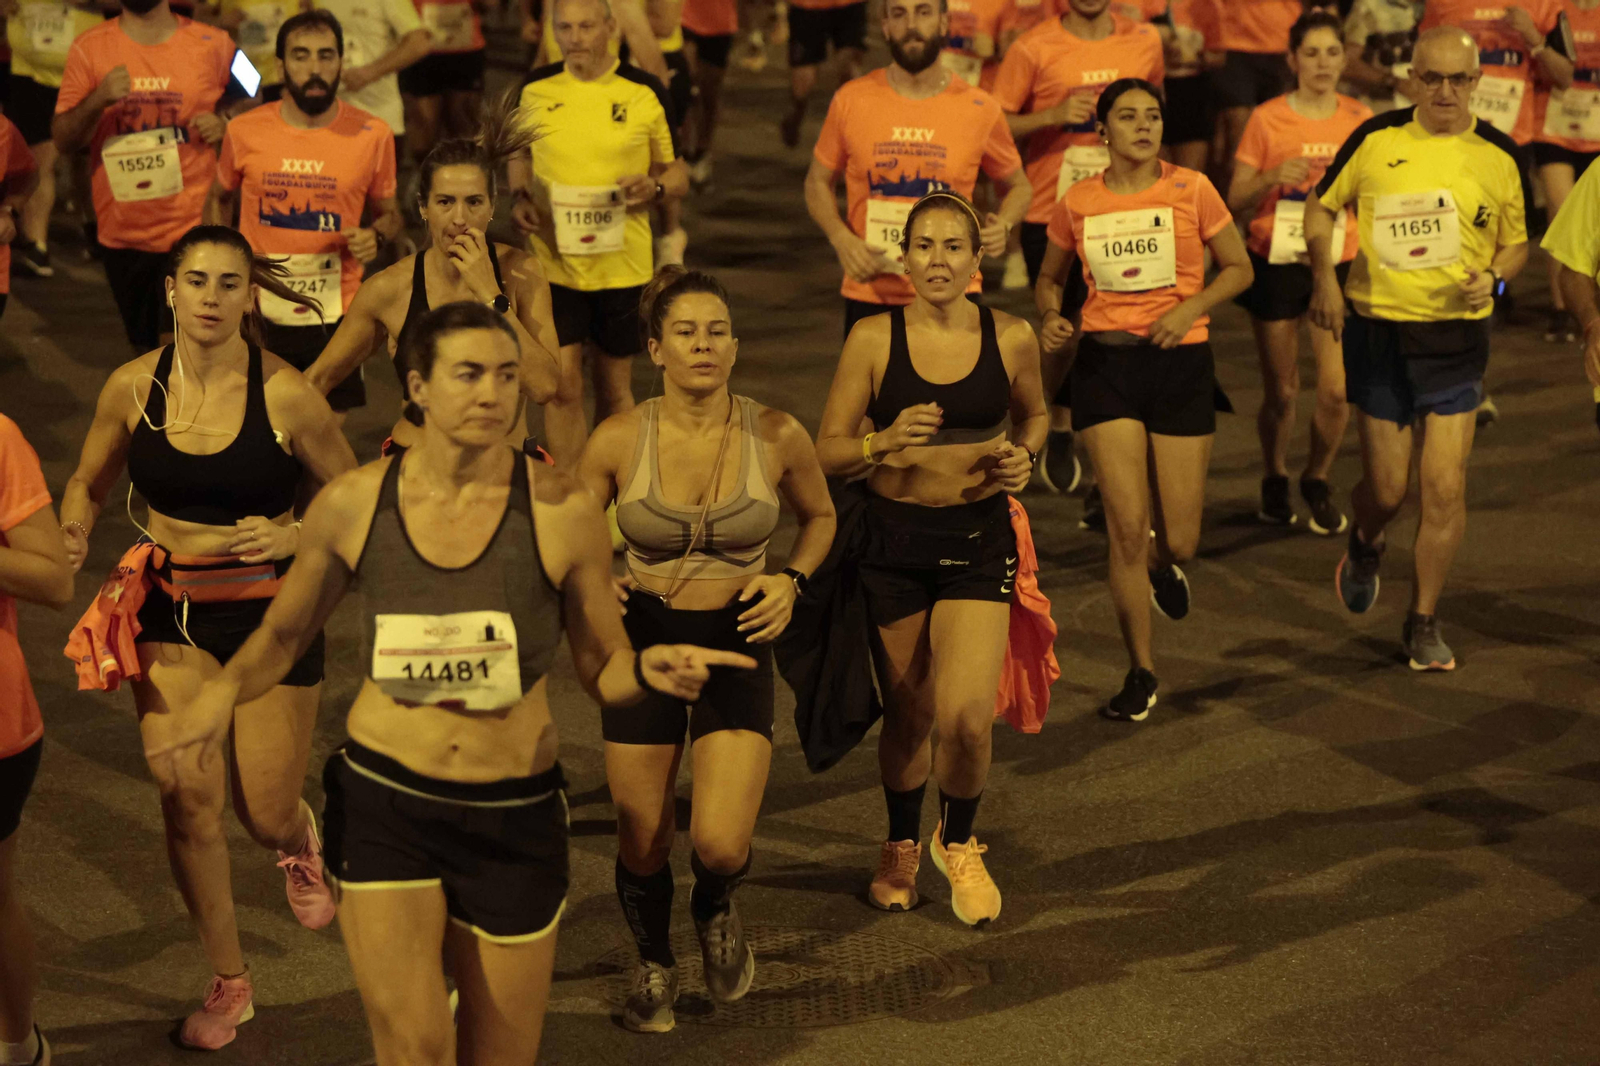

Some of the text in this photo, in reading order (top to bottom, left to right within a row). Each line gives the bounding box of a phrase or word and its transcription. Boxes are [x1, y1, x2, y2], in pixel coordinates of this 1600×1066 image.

[133, 77, 171, 91] XXXV
[891, 126, 935, 142] XXXV
[118, 154, 166, 173] 15525
[281, 158, 325, 174] XXXV
[565, 209, 613, 226] 11806
[1388, 217, 1442, 239] 11651
[1101, 236, 1159, 258] 10466
[401, 658, 490, 682] 14481
